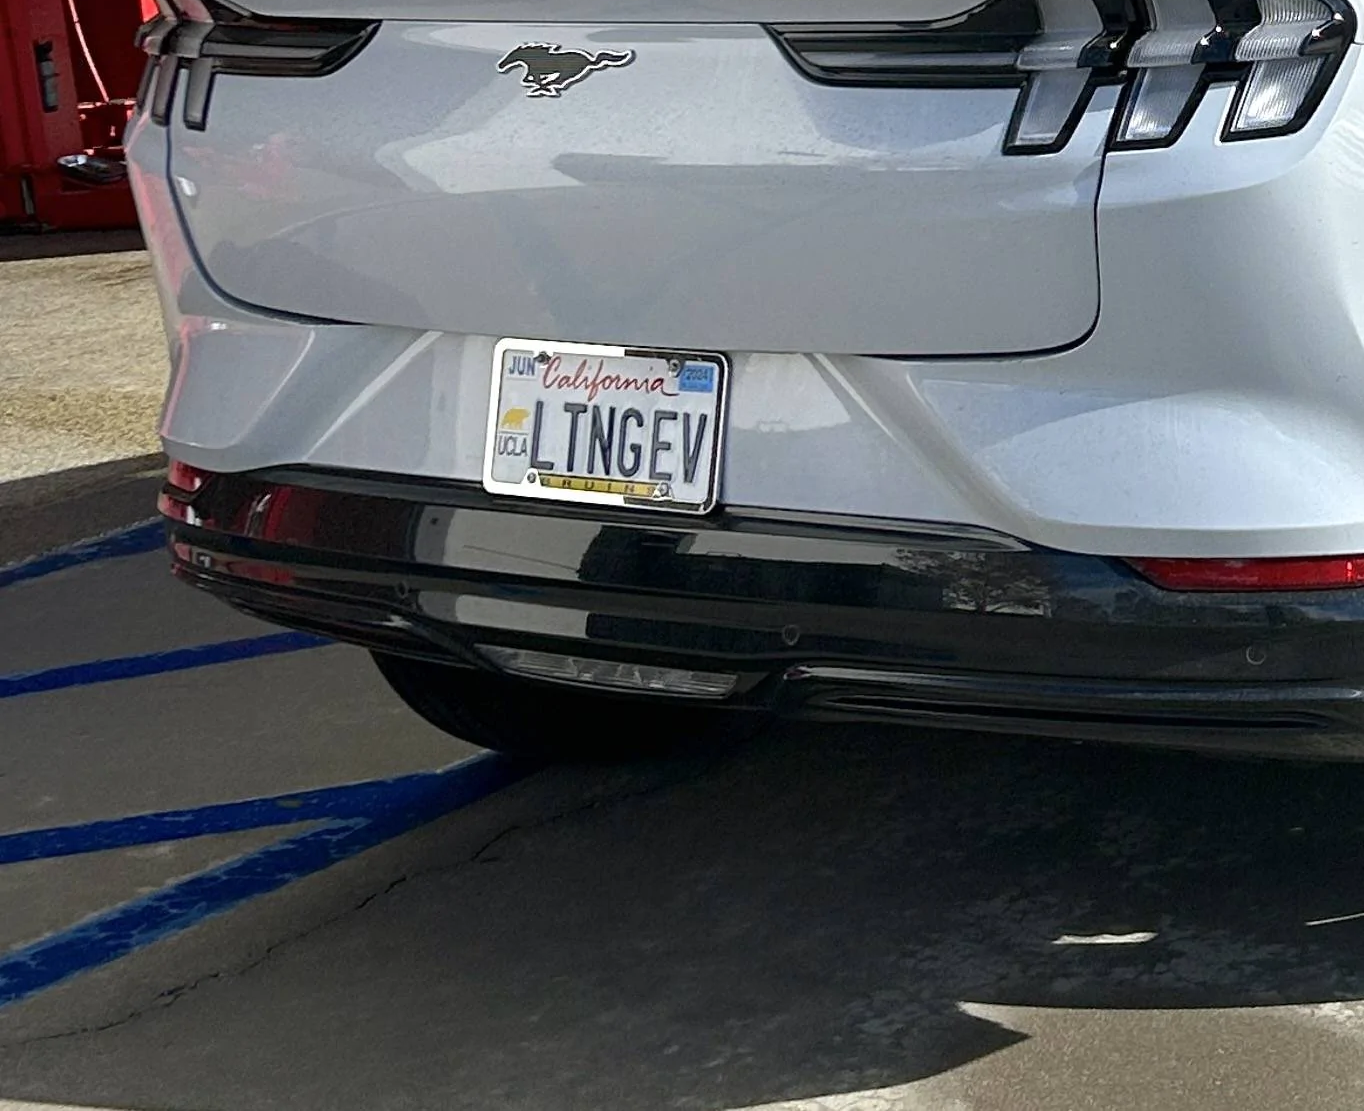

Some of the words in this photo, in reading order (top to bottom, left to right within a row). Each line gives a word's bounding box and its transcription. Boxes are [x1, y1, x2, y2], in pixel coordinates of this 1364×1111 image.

[508, 356, 536, 377] JUN
[542, 355, 680, 401] California
[498, 435, 528, 457] UCLA
[530, 400, 708, 484] LTNGEV
